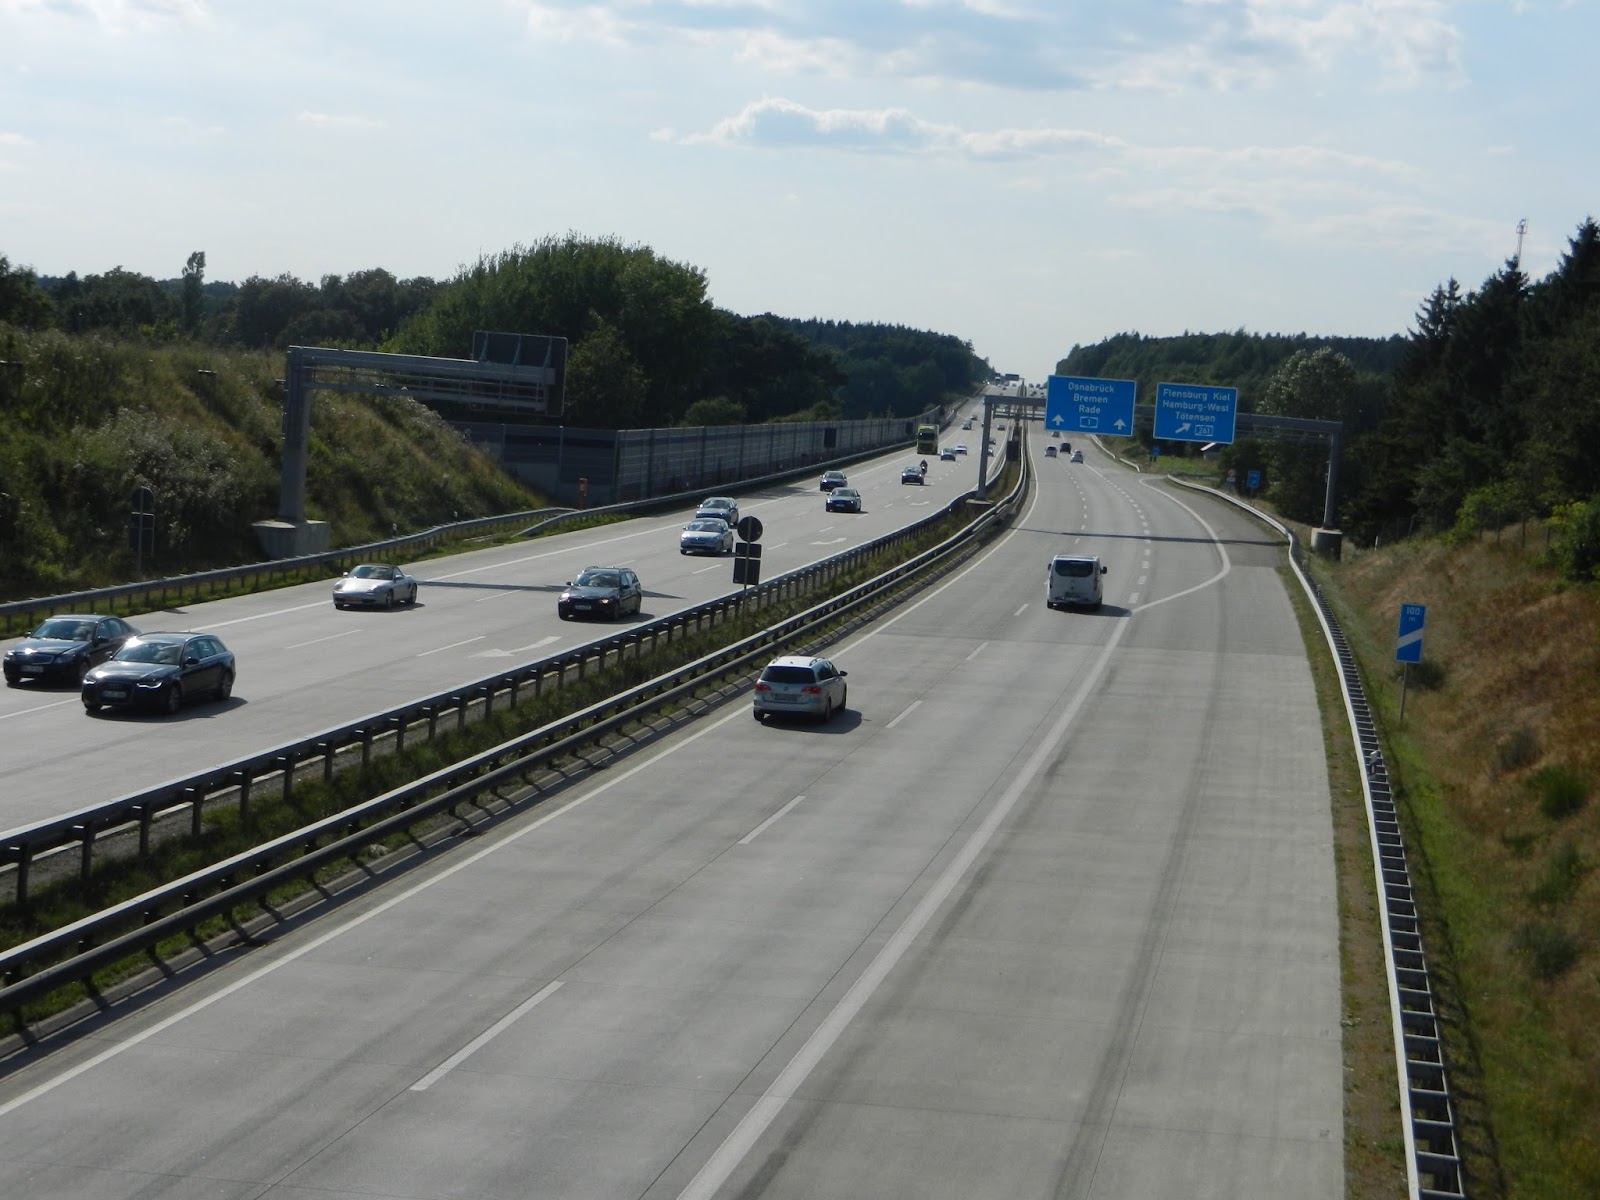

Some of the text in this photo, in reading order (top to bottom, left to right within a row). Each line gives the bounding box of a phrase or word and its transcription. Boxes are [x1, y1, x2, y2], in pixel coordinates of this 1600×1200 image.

[1068, 381, 1115, 393] Osnabrück
[1073, 393, 1108, 403] Bremen
[1163, 388, 1230, 401] Flensburg Kiel
[1078, 404, 1101, 414] Rade
[1162, 400, 1229, 412] Hamburg-West
[1198, 426, 1211, 434] 261
[1406, 606, 1420, 616] 100
